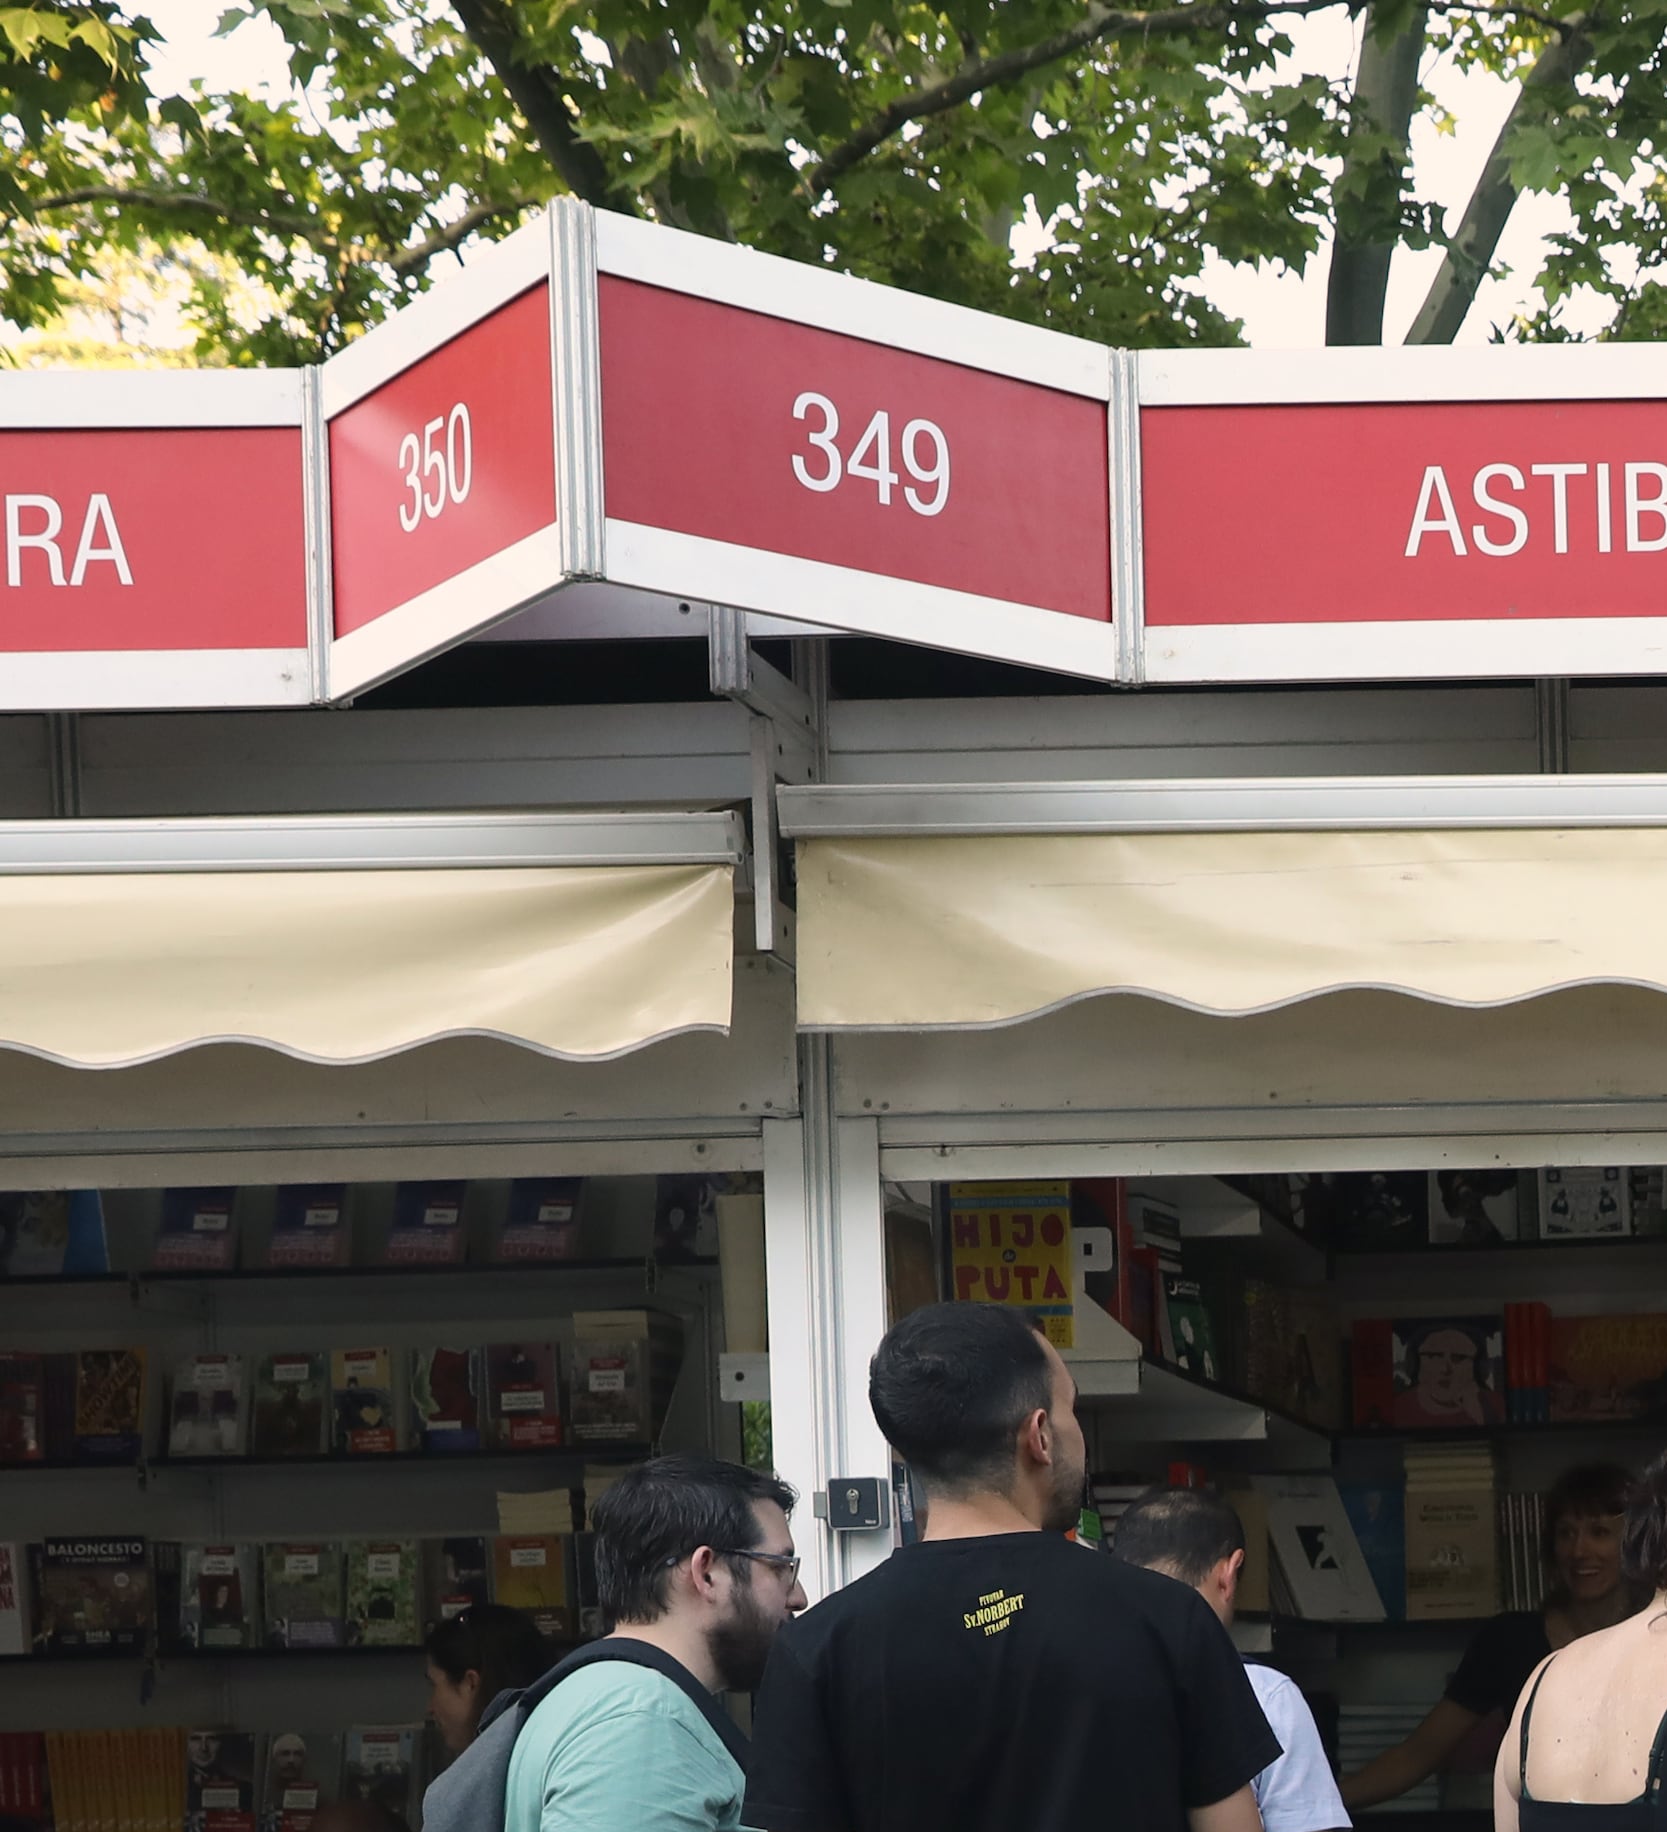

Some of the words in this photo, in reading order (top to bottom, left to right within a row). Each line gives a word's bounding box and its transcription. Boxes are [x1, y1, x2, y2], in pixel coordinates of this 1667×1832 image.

[397, 402, 472, 533] 350
[792, 392, 949, 516] 349
[6, 493, 133, 586] RA
[954, 1214, 1064, 1247] HIJO
[956, 1264, 1067, 1300] PUTA
[47, 1542, 143, 1557] BALONCESTO
